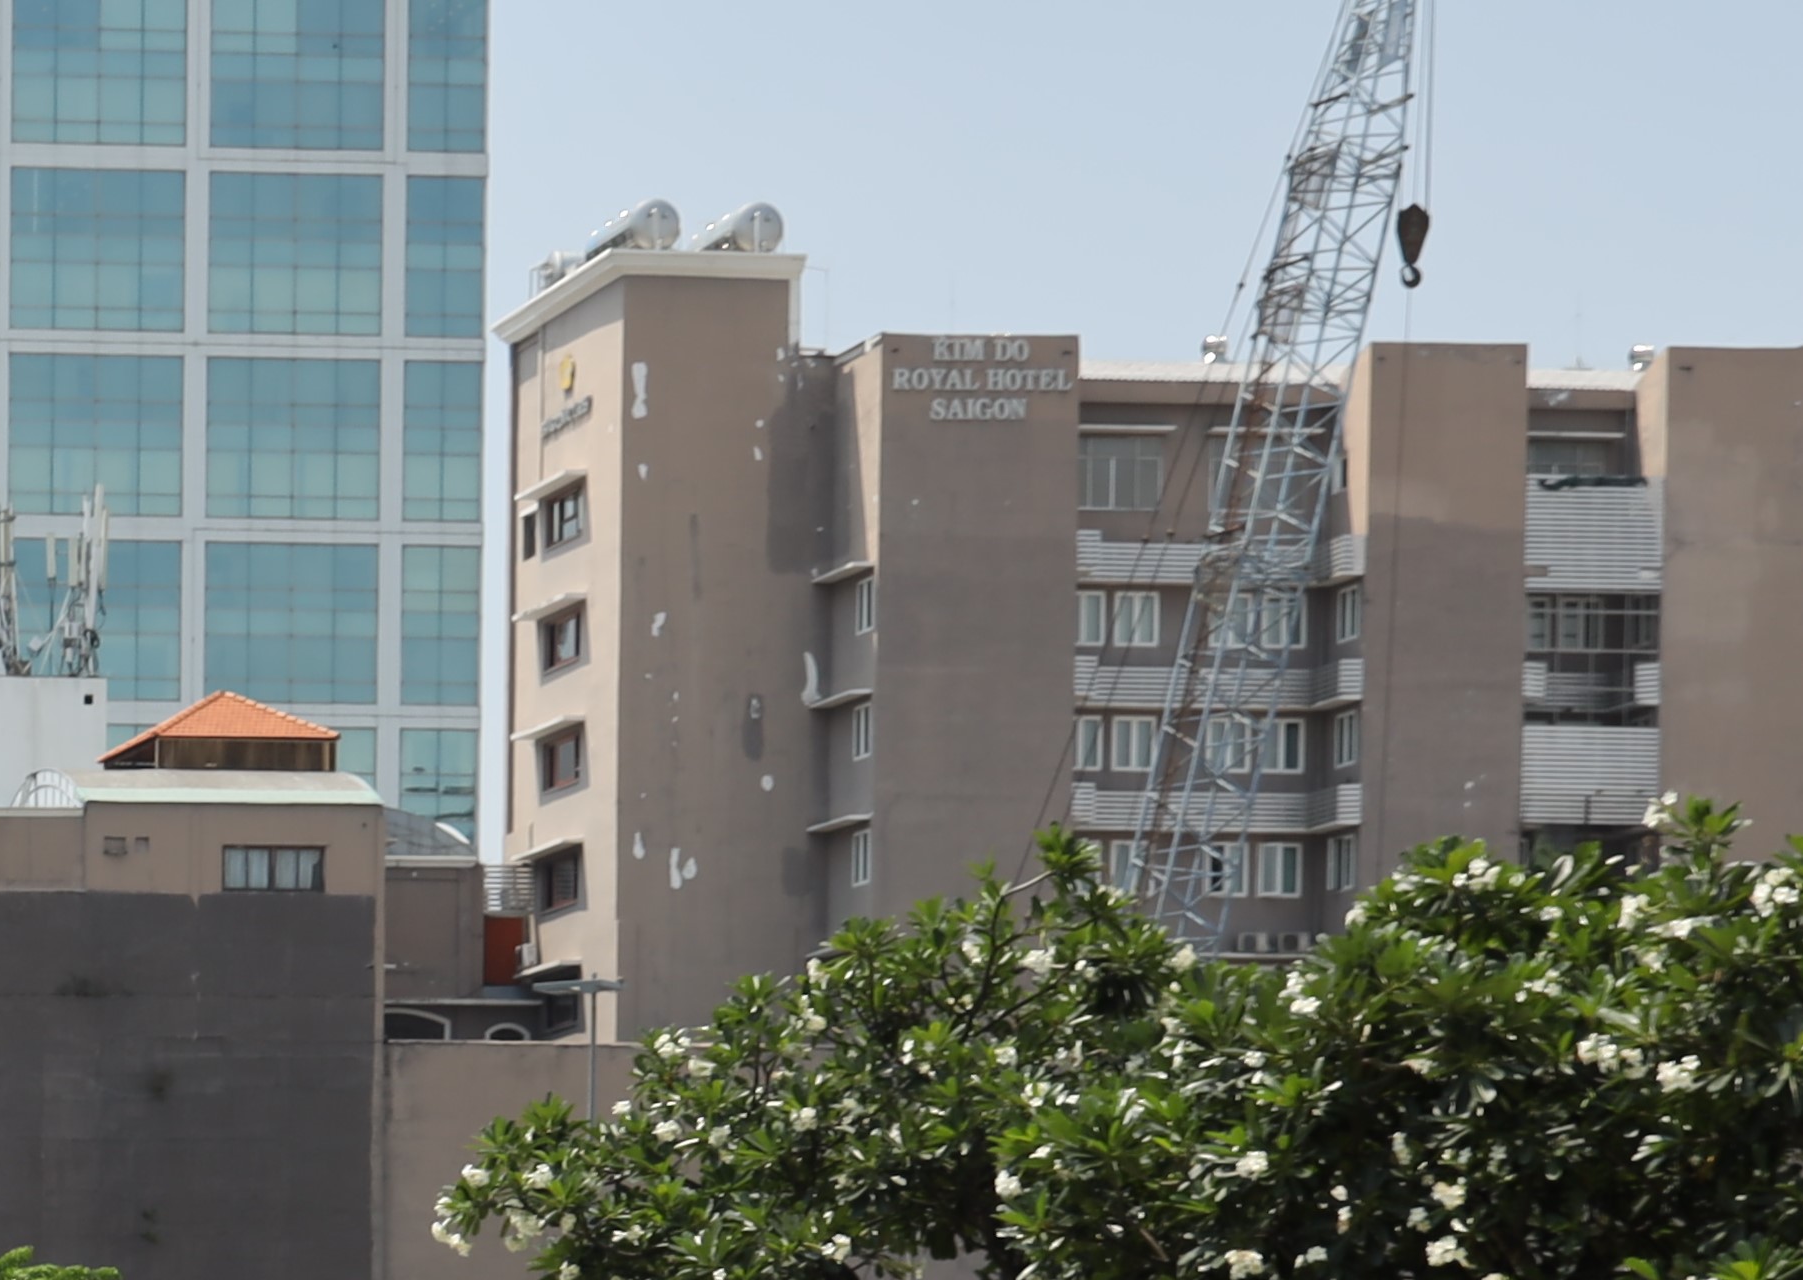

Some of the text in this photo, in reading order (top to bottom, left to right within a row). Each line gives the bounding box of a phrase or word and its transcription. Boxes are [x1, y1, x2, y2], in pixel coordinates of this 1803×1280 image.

[933, 337, 1030, 362] KIM DO
[892, 368, 1073, 391] ROYAL HOTEL
[929, 398, 1028, 420] SAIGON
